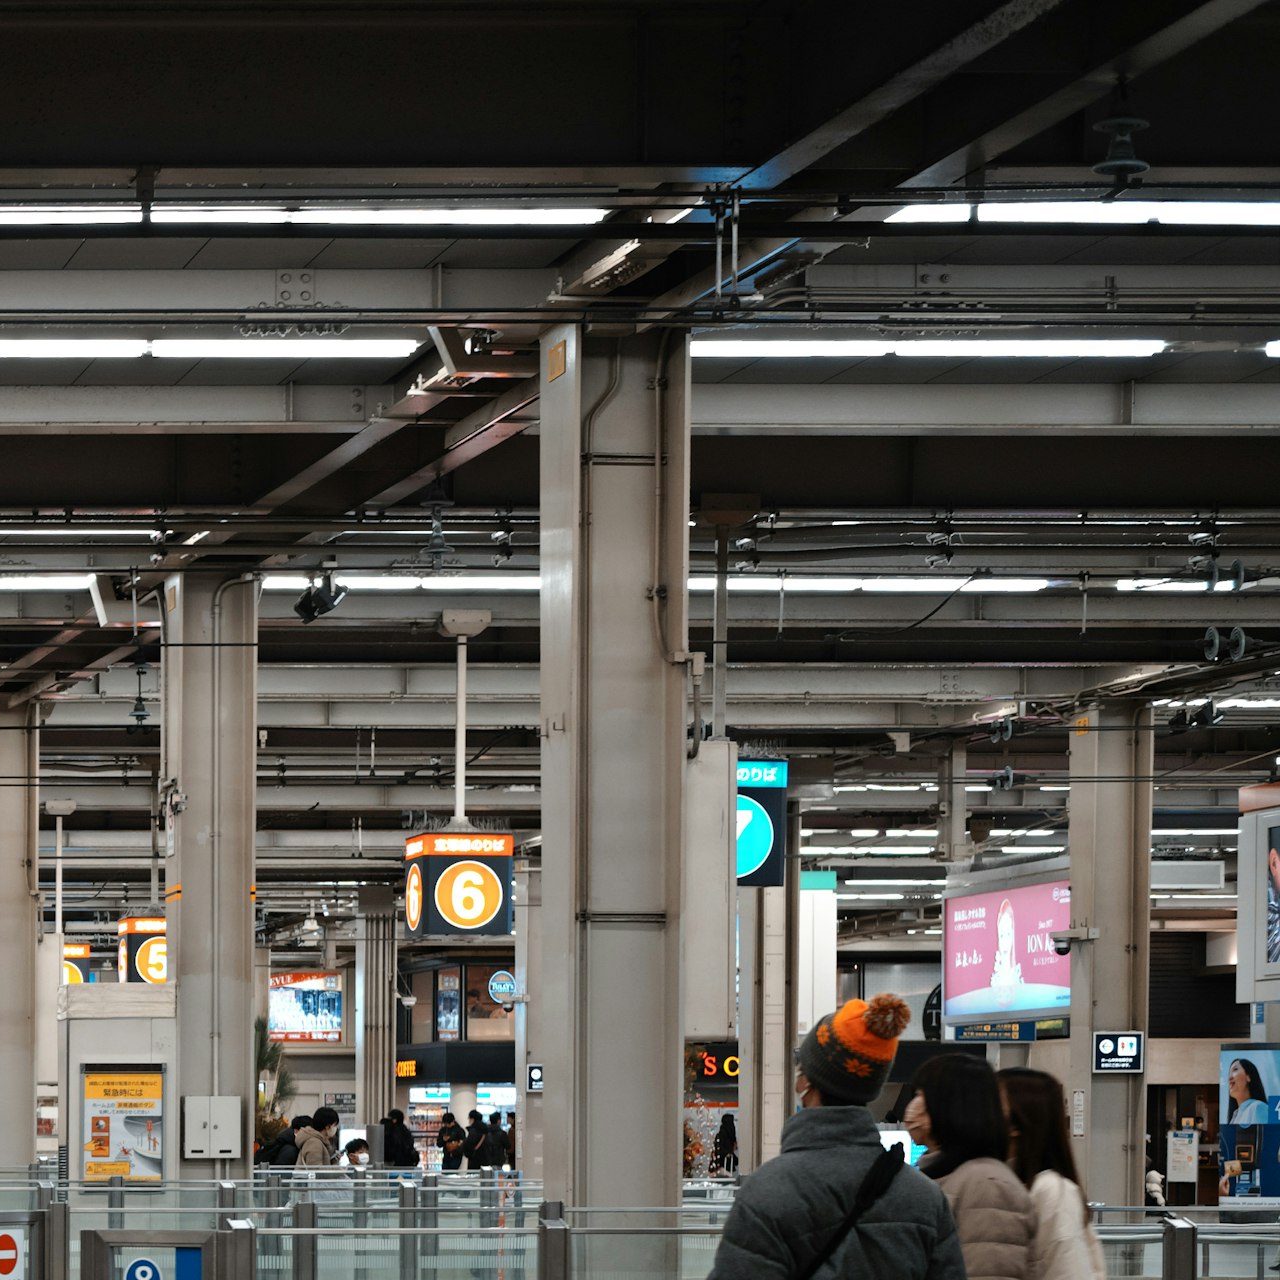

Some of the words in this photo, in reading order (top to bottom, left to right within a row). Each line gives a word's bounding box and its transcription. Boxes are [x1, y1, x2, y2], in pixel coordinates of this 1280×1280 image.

[410, 874, 418, 922] 6
[452, 870, 485, 920] 6
[147, 944, 166, 979] 5
[398, 1060, 416, 1077] COFFEE
[103, 1089, 143, 1097] 緊急時には
